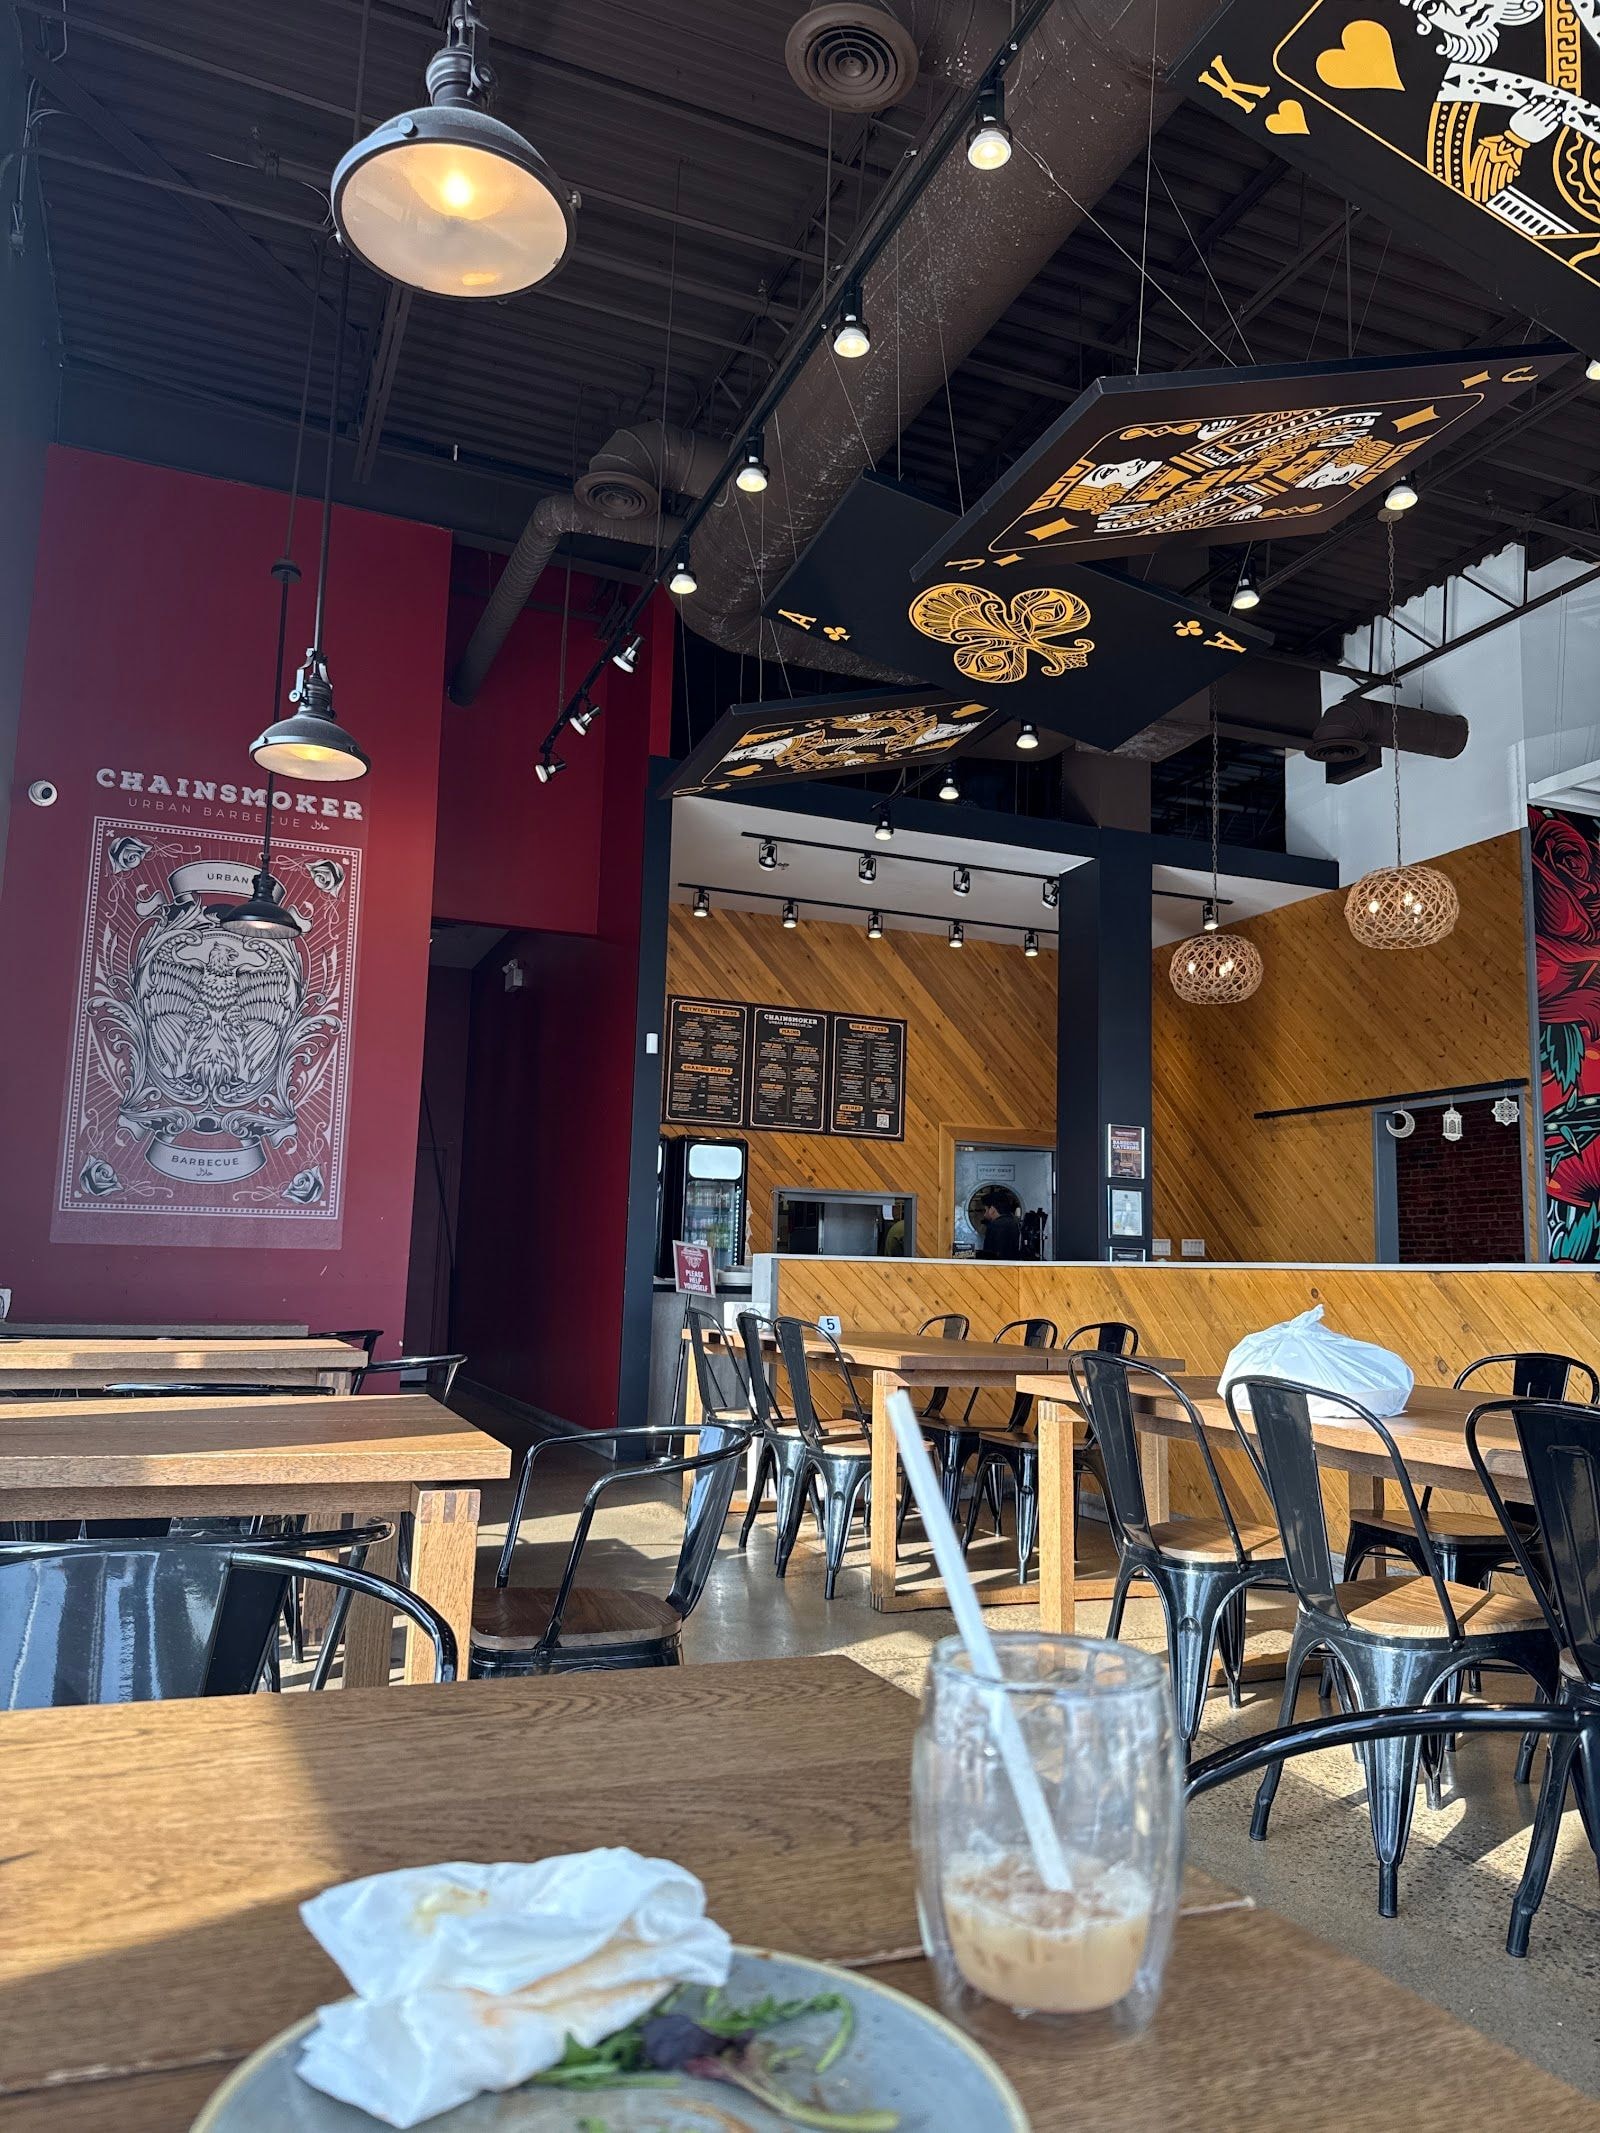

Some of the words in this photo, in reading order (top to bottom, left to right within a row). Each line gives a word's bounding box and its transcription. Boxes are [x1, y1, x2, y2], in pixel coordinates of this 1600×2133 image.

[1198, 54, 1271, 114] K
[777, 608, 818, 631] A
[1203, 630, 1247, 653] A
[96, 767, 364, 821] CHAINSMOKER
[128, 797, 192, 814] URBAN
[206, 872, 250, 885] URBAN
[763, 1014, 818, 1025] CHAINSMOKER
[170, 1154, 240, 1167] BARBECUE
[685, 1270, 704, 1279] PLEASE
[683, 1282, 709, 1292] YOURSELF
[826, 1318, 835, 1331] 5
